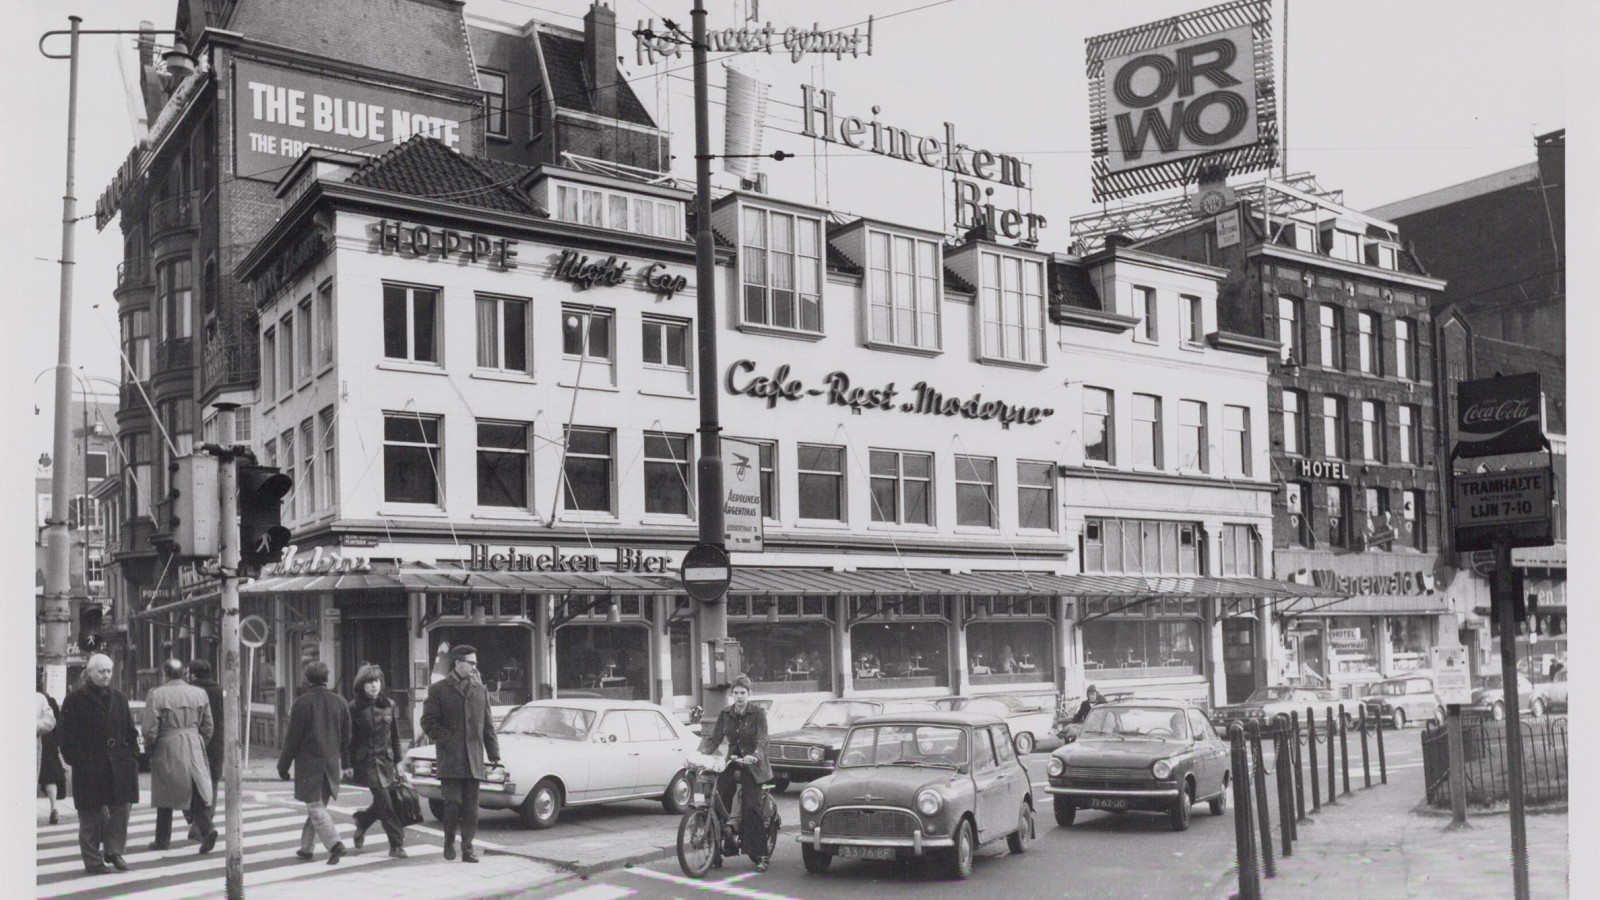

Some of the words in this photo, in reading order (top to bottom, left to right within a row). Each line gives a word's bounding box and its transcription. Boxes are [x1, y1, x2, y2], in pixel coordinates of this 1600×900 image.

[248, 81, 305, 128] THE
[313, 94, 384, 142] BLUE
[249, 132, 276, 155] THE
[280, 138, 320, 158] FIR
[801, 84, 1026, 188] Heineken
[953, 178, 1048, 243] Bier
[378, 219, 519, 272] HOPPE
[554, 249, 632, 291] Night
[646, 262, 688, 300] Cap
[1463, 398, 1532, 424] Coca-Cola
[1301, 460, 1350, 480] HOTEL
[1461, 476, 1542, 496] TRAMHALTE
[1470, 503, 1499, 518] LIJN
[1502, 501, 1533, 516] 7-10
[470, 543, 600, 572] Heineken
[616, 547, 674, 573] Bier
[1332, 629, 1356, 638] HOTEL
